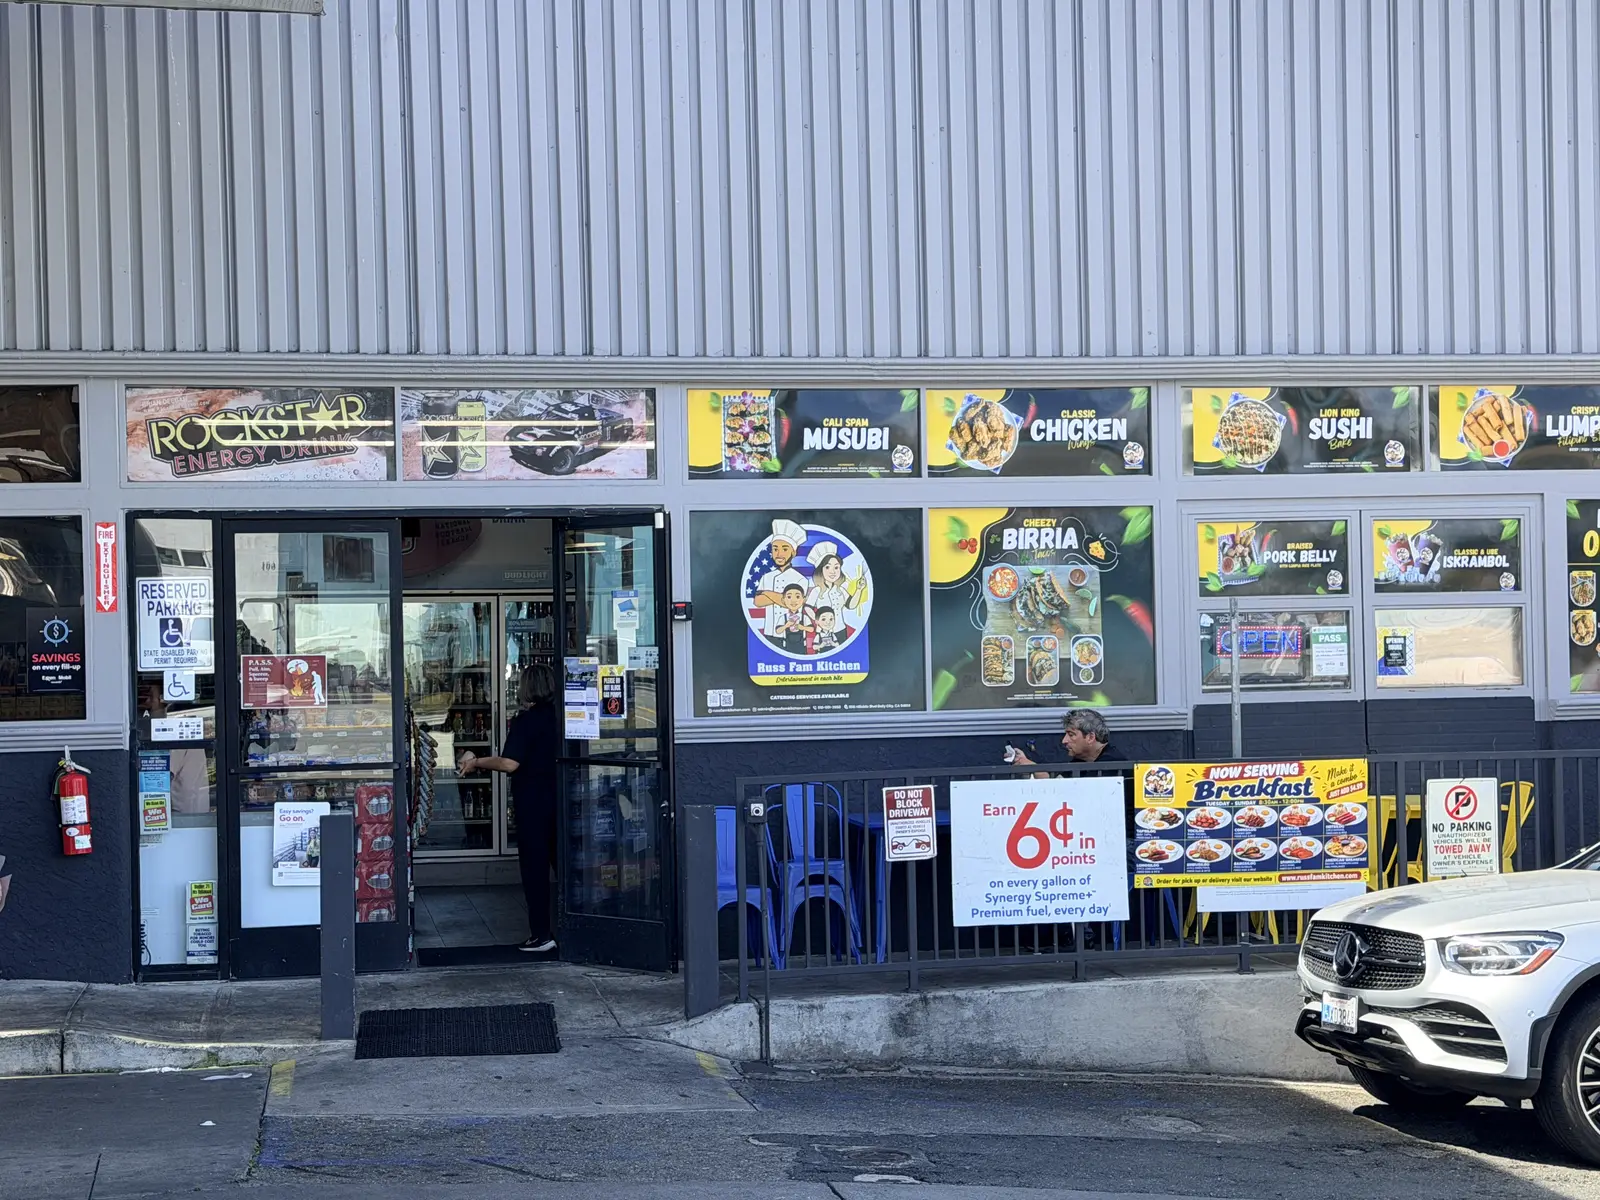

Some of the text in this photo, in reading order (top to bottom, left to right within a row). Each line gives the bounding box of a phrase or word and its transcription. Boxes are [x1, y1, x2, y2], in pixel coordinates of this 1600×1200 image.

[1061, 410, 1096, 419] CLASSIC
[1319, 408, 1360, 417] LION KING
[1571, 406, 1599, 415] CRISPY
[823, 418, 869, 427] CALI SPAM
[1308, 417, 1373, 440] SUSHI
[1030, 418, 1127, 442] CHICKEN
[803, 427, 890, 450] MUSUBI
[1068, 439, 1096, 450] Wings
[1327, 438, 1352, 450] Bake
[174, 433, 358, 474] ENERGY DRINK
[1023, 518, 1057, 527] CHEEZY
[98, 530, 113, 539] FIRE
[1003, 527, 1079, 550] BIRRIA
[1286, 542, 1313, 550] BRAISED
[1264, 550, 1337, 564] PORK BELLY
[1443, 555, 1509, 568] ISKRAMBOL
[141, 583, 207, 600] RESERVED
[147, 601, 202, 617] PARKING
[1220, 630, 1299, 653] OPEN
[1318, 634, 1341, 643] PASS
[32, 653, 81, 663] SAVINGS
[757, 661, 861, 673] Russ Fam Kitchen
[1209, 763, 1299, 779] NOW SERVING
[1327, 763, 1355, 781] Make it
[1337, 773, 1358, 786] combo
[894, 789, 923, 799] DO NOT
[1194, 777, 1314, 801] Breakfast
[896, 799, 923, 808] BLOCK
[983, 803, 1016, 816] Earn
[145, 814, 166, 822] Card
[279, 814, 292, 822] Go
[889, 807, 930, 818] DRIVEWAY
[1432, 822, 1492, 832] NO PARKING
[1006, 801, 1074, 869] 6¢
[1079, 832, 1096, 849] in
[1434, 844, 1491, 854] TOWED AWAY
[1052, 852, 1096, 869] points
[989, 875, 1091, 891] on every gallon of
[1181, 876, 1193, 885] pick
[1209, 876, 1231, 884] delivery
[1281, 872, 1358, 882] www.russfamkitchen.com
[985, 892, 1032, 906] Synergy
[192, 902, 212, 910] Card
[971, 906, 1023, 919] Premium
[1026, 906, 1052, 917] fuel,
[1055, 906, 1084, 917] every
